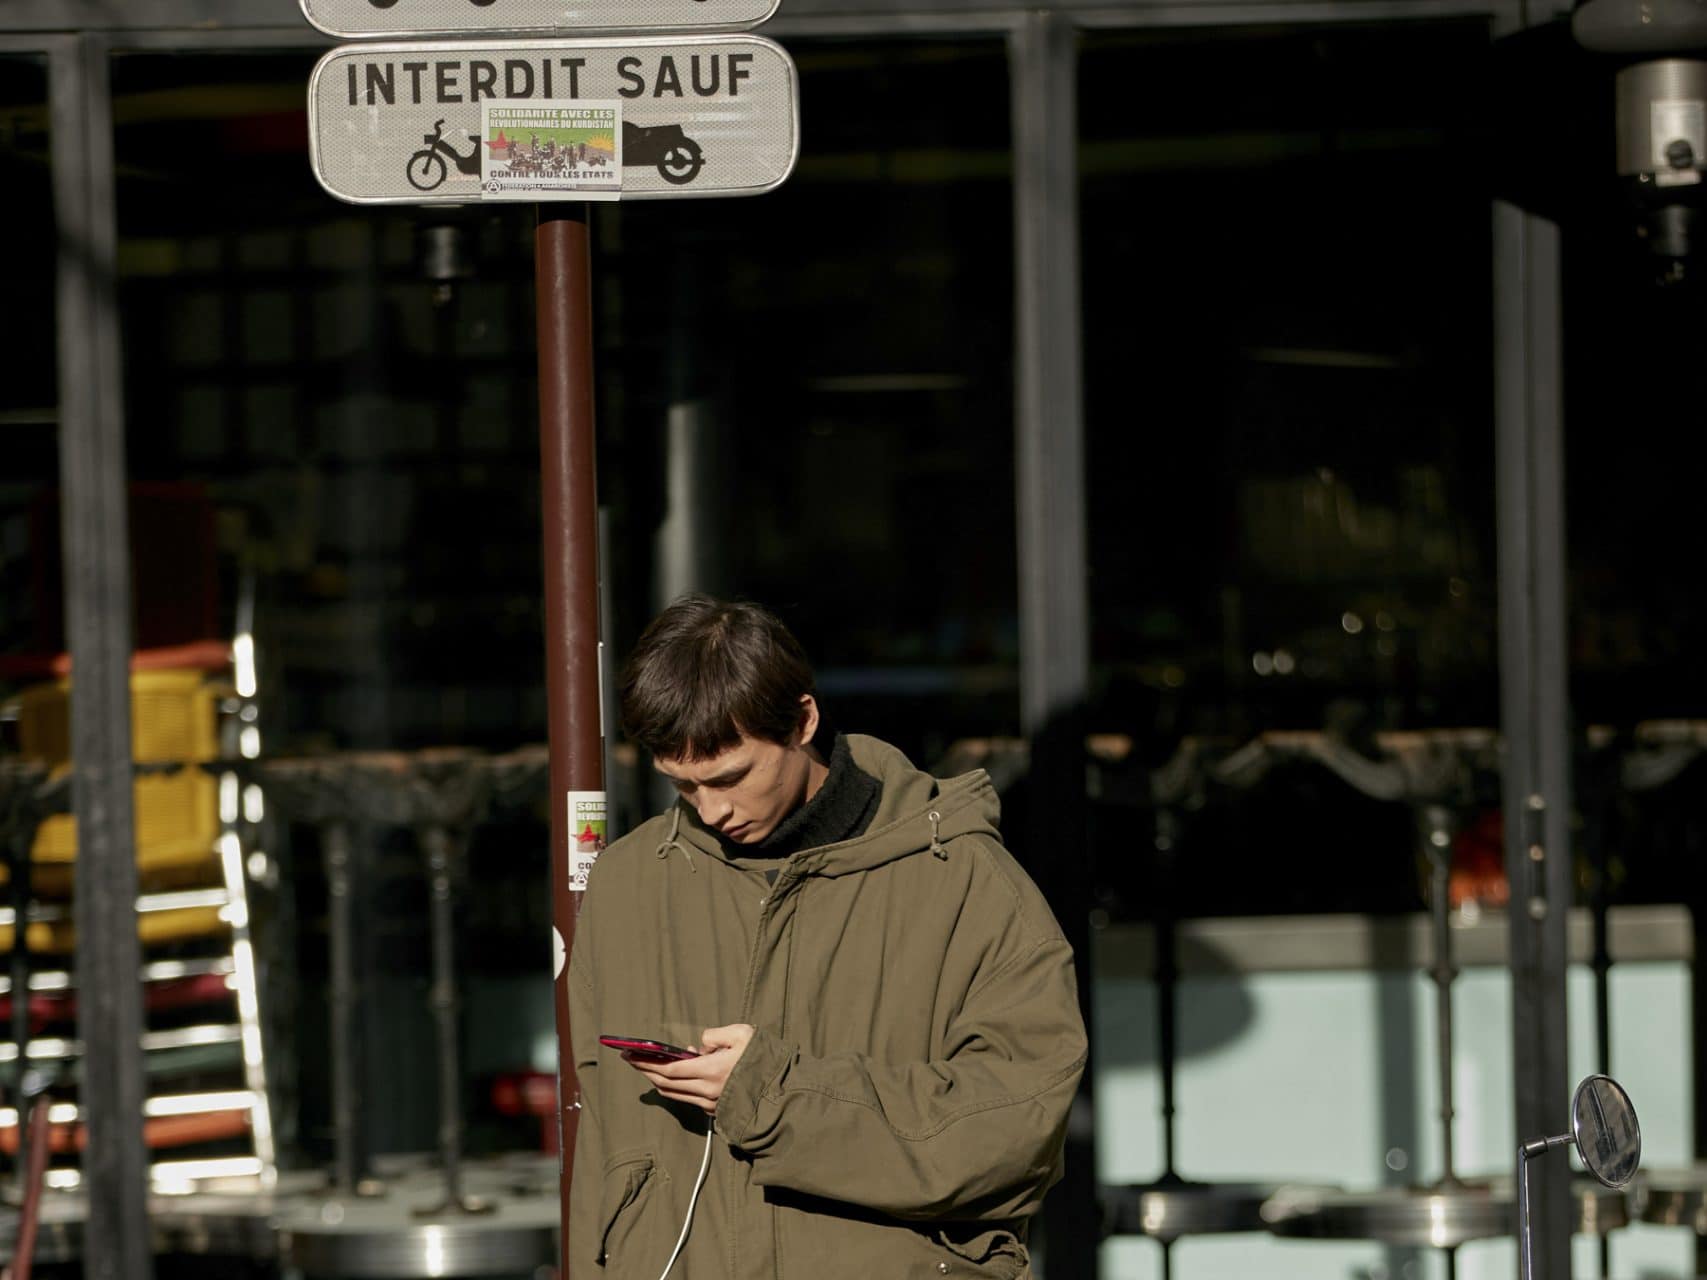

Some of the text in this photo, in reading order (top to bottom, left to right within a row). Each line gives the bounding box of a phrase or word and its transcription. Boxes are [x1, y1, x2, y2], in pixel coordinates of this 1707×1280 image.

[348, 53, 753, 105] INTERDIT SAUF
[560, 109, 591, 119] AVEC
[593, 109, 613, 119] LES
[490, 170, 614, 179] CONTRE TOUS LES ETATS
